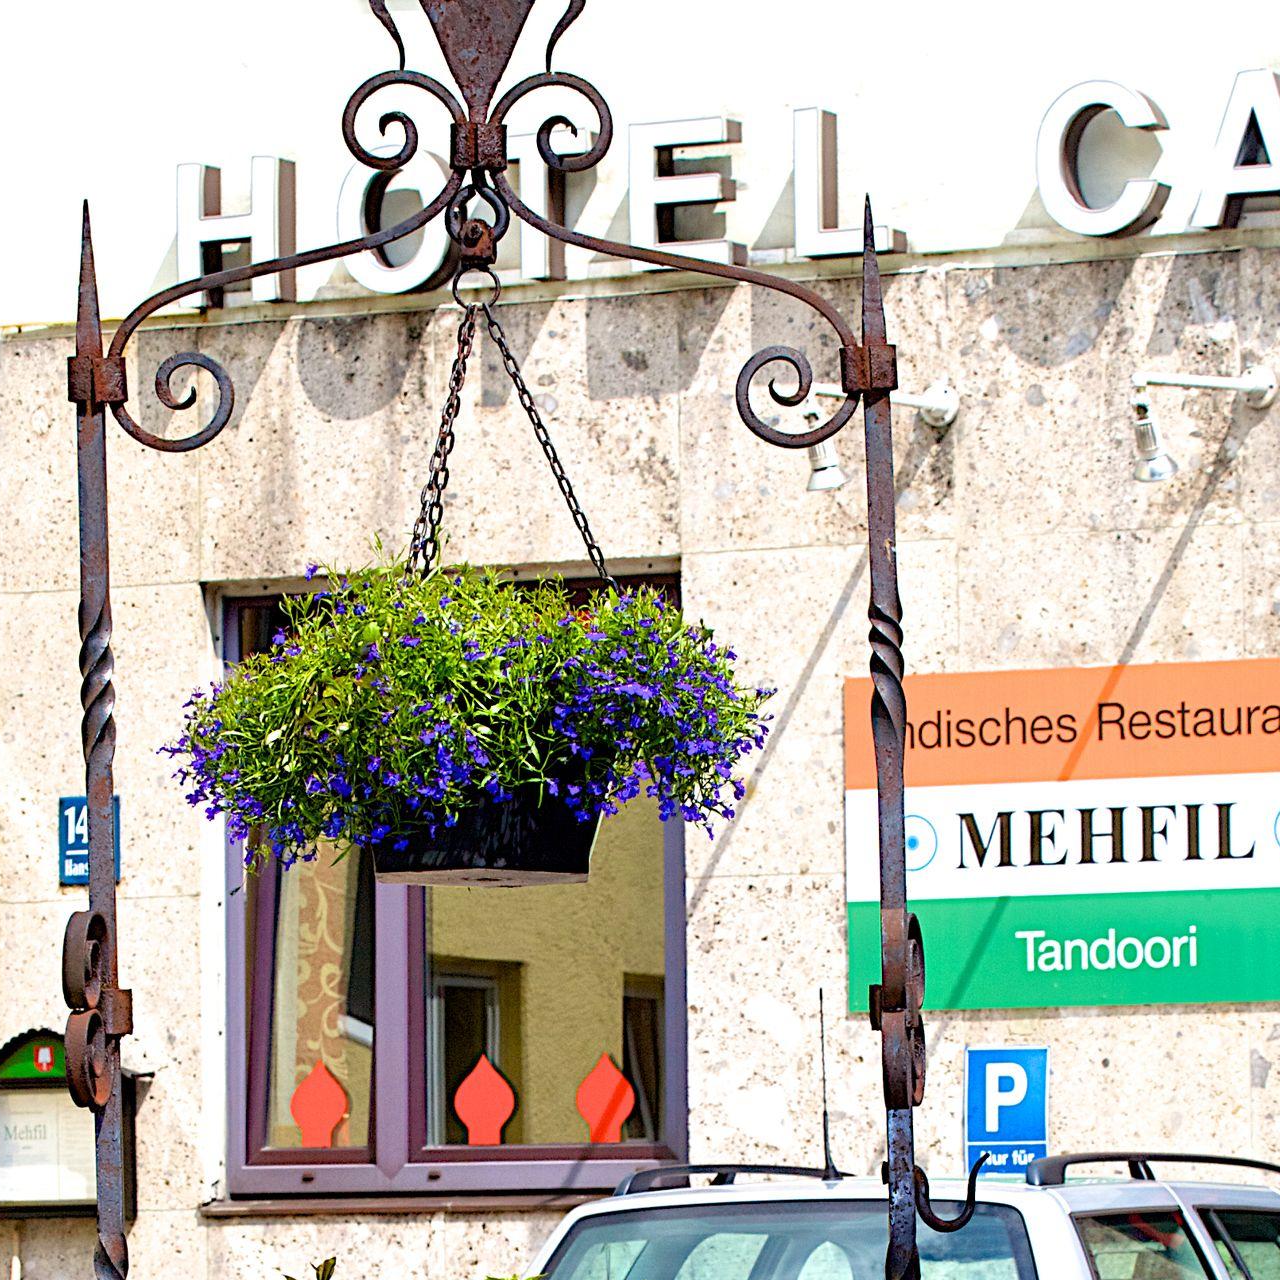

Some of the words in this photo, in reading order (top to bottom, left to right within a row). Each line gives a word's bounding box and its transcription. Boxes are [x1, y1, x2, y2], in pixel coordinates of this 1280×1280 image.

[176, 106, 907, 308] HOTEL
[904, 707, 1078, 750] ndisches
[955, 801, 1256, 870] MEHFIL
[1015, 925, 1199, 973] Tandoori
[985, 1061, 1028, 1133] P
[3, 1124, 48, 1141] Mehfil
[1011, 1149, 1036, 1166] für
